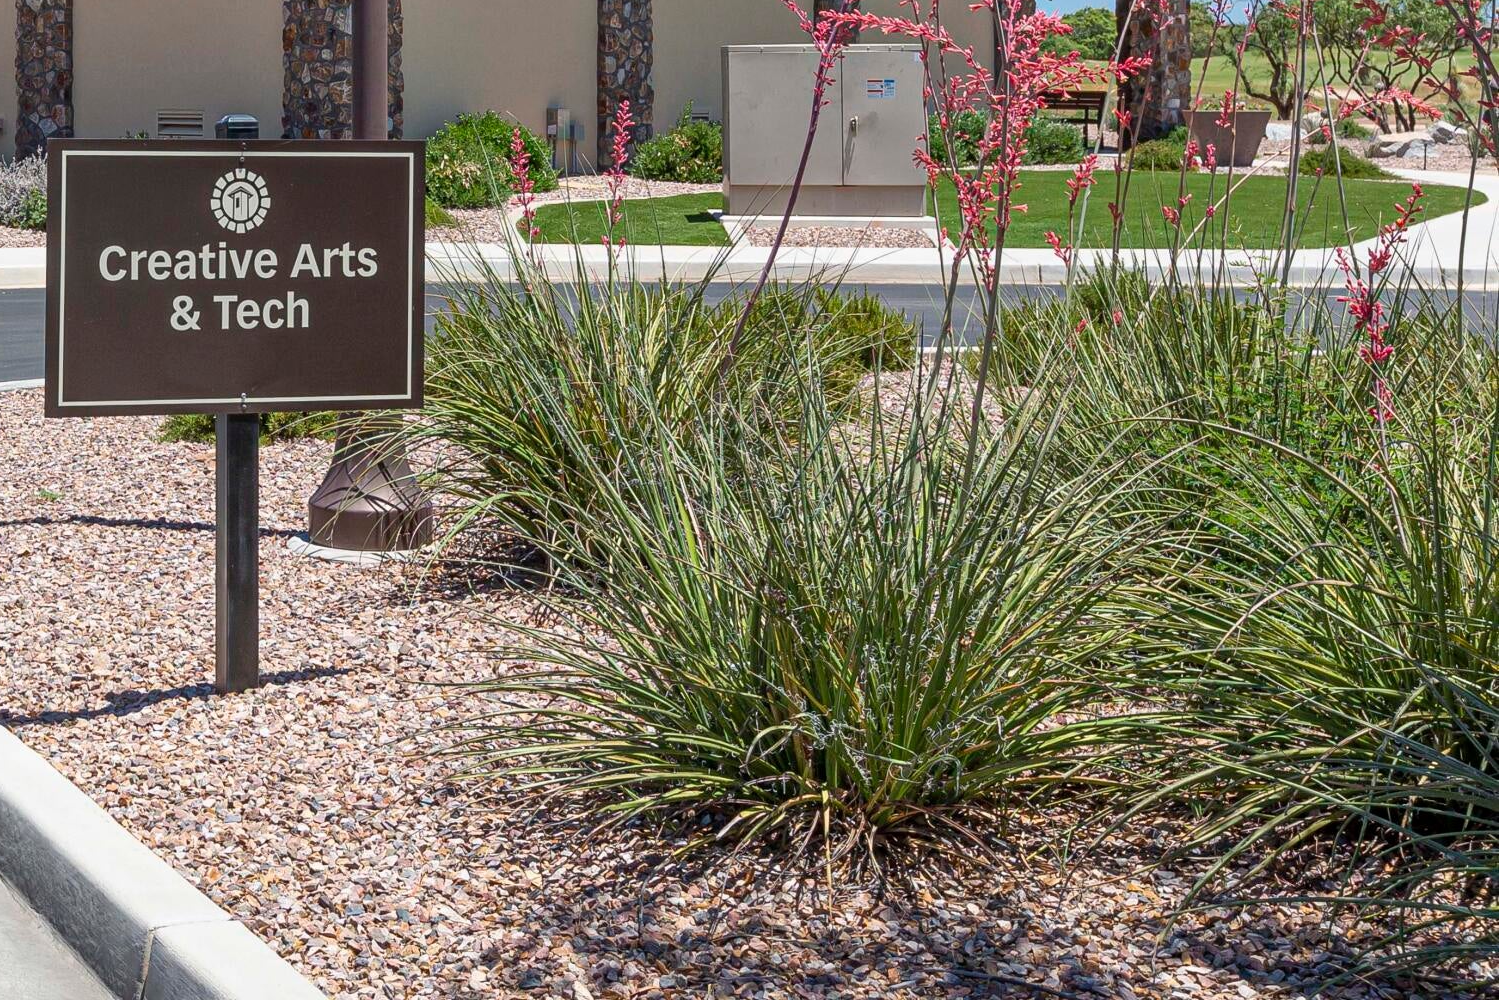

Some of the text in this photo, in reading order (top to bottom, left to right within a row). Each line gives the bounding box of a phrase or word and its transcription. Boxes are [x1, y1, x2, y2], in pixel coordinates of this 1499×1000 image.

[99, 242, 378, 281] Creative Arts
[169, 291, 310, 331] & Tech
